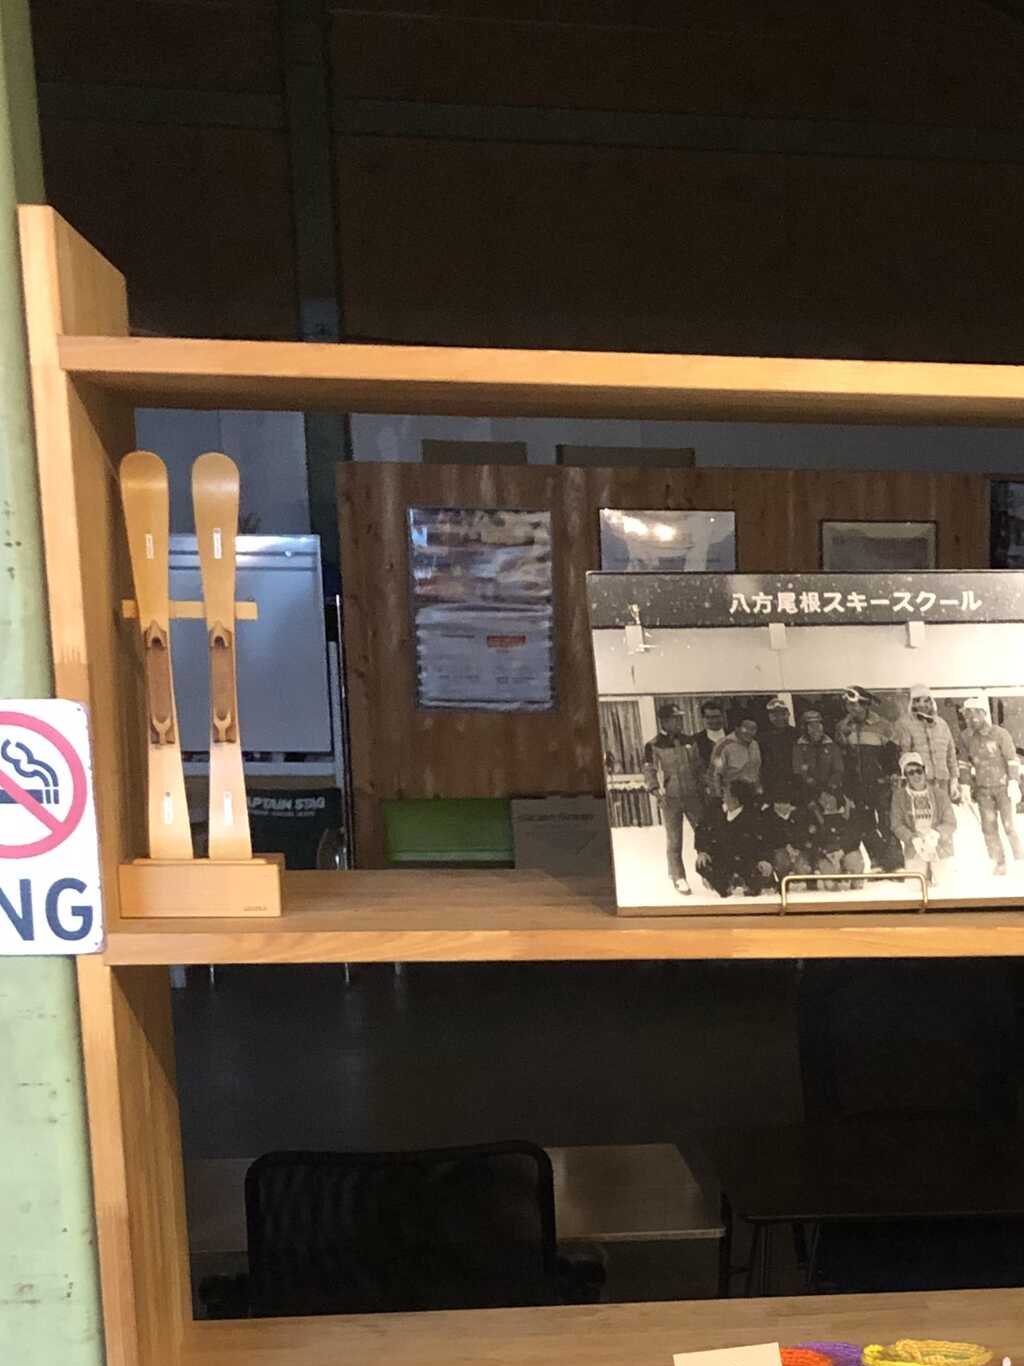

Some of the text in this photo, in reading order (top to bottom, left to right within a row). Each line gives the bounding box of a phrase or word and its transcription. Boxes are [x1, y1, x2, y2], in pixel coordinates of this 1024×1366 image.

[729, 590, 983, 614] 八方尾根スキースクール
